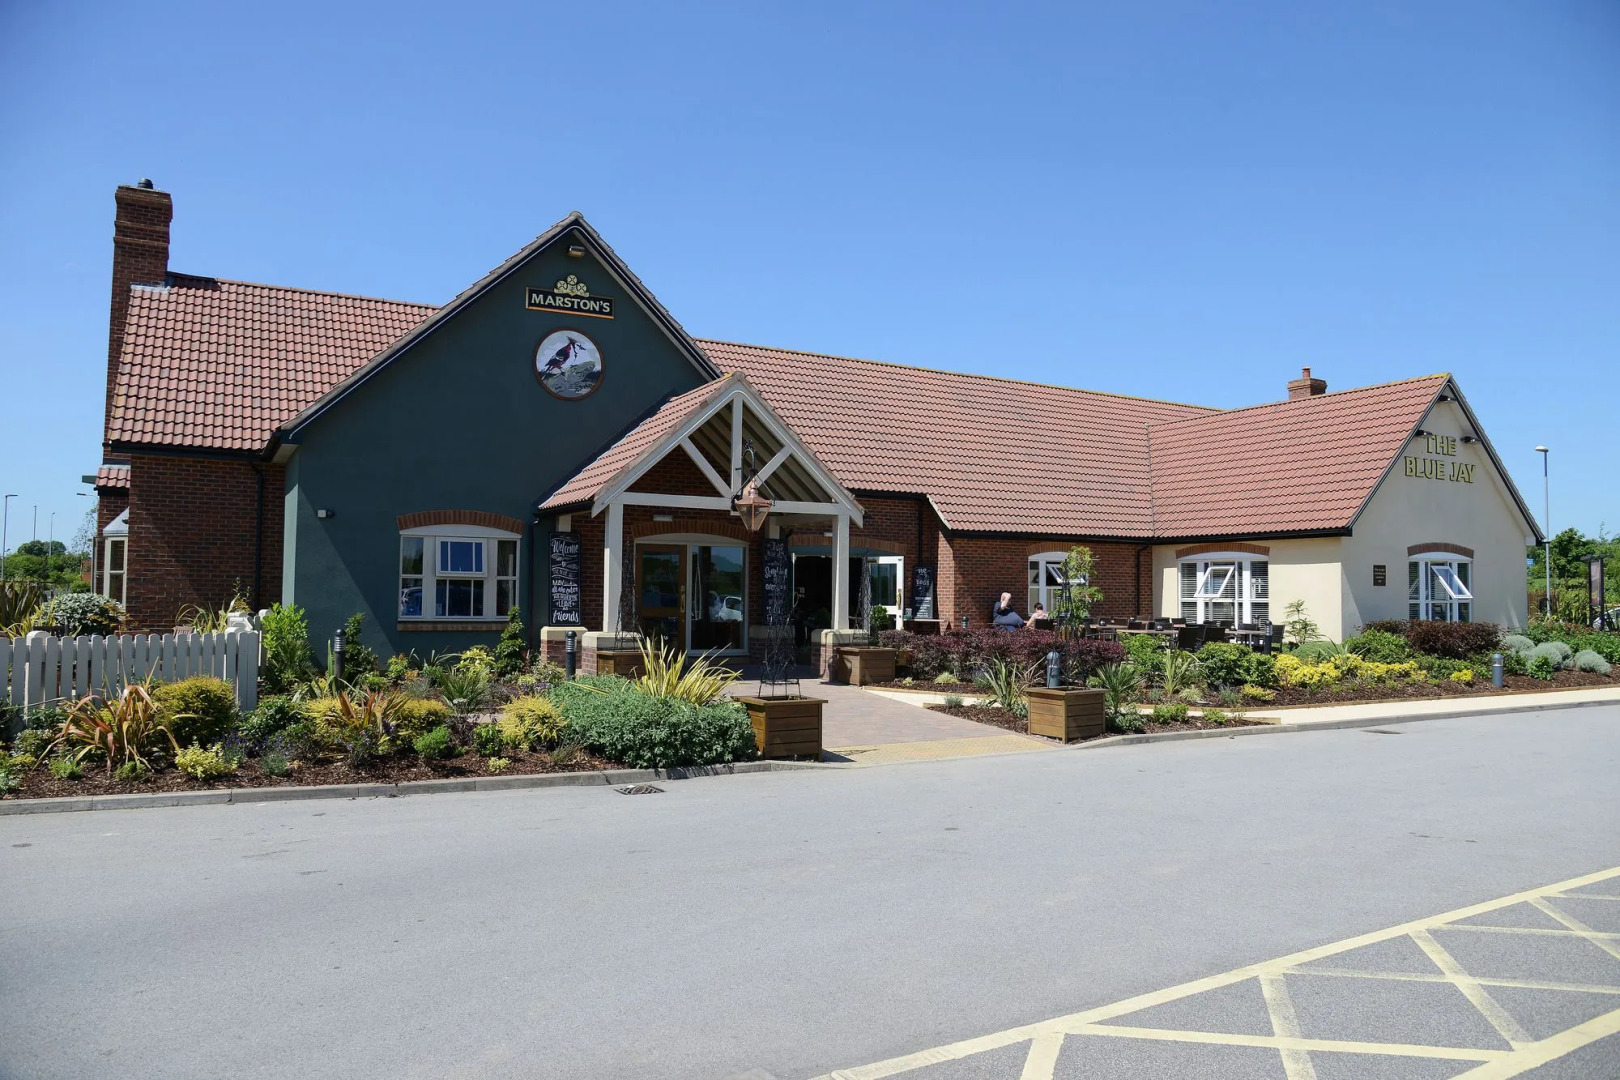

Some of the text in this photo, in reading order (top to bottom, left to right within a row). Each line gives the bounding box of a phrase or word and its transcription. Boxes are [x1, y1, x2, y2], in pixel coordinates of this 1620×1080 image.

[531, 293, 611, 313] MARSTON'S
[1427, 435, 1457, 456] THE
[1404, 456, 1476, 483] BLUE JAY
[551, 540, 579, 557] Welcome
[552, 610, 579, 624] friends
